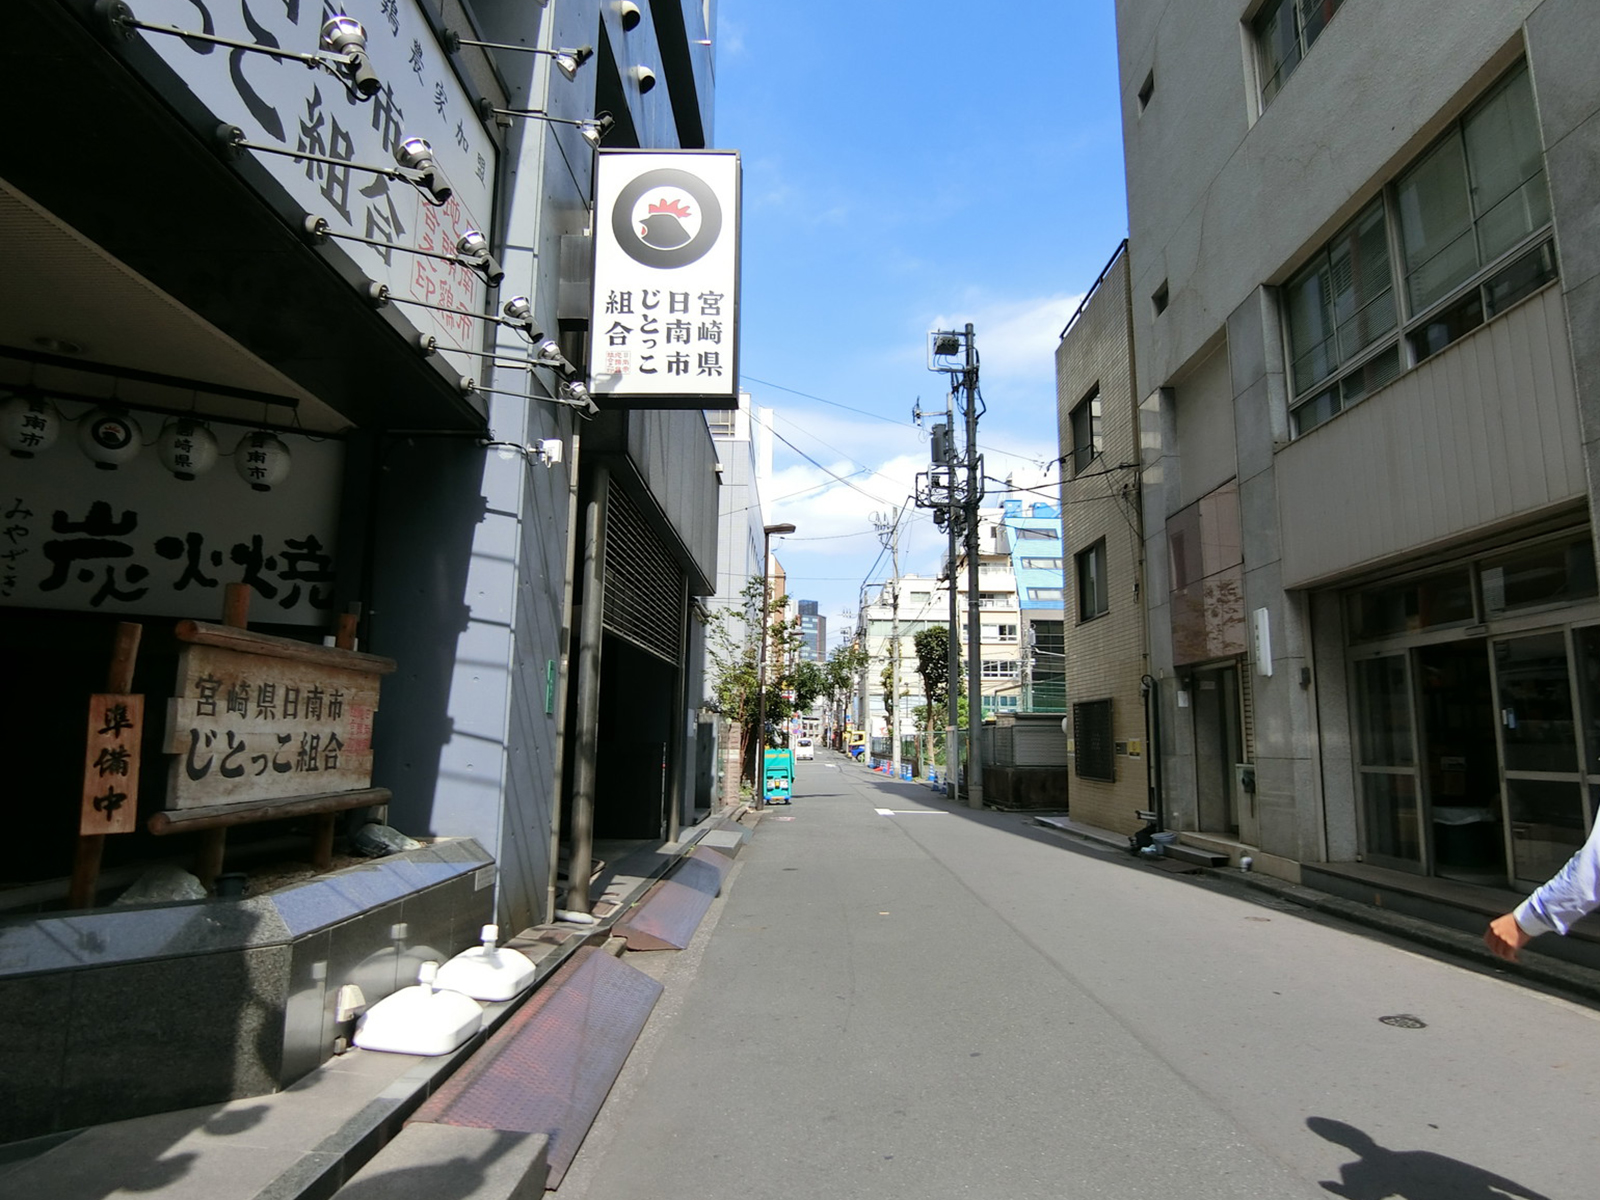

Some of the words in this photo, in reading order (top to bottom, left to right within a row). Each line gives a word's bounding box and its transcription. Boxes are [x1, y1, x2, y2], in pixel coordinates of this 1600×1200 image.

[604, 289, 634, 347] 組合
[638, 288, 661, 375] じとっこ
[666, 290, 692, 377] 日南市
[697, 290, 725, 377] 宮崎県
[39, 500, 336, 609] 炭火焼
[195, 673, 345, 721] 宮崎県日南市
[92, 702, 135, 822] 準備中
[185, 727, 344, 782] じとっこ組合
